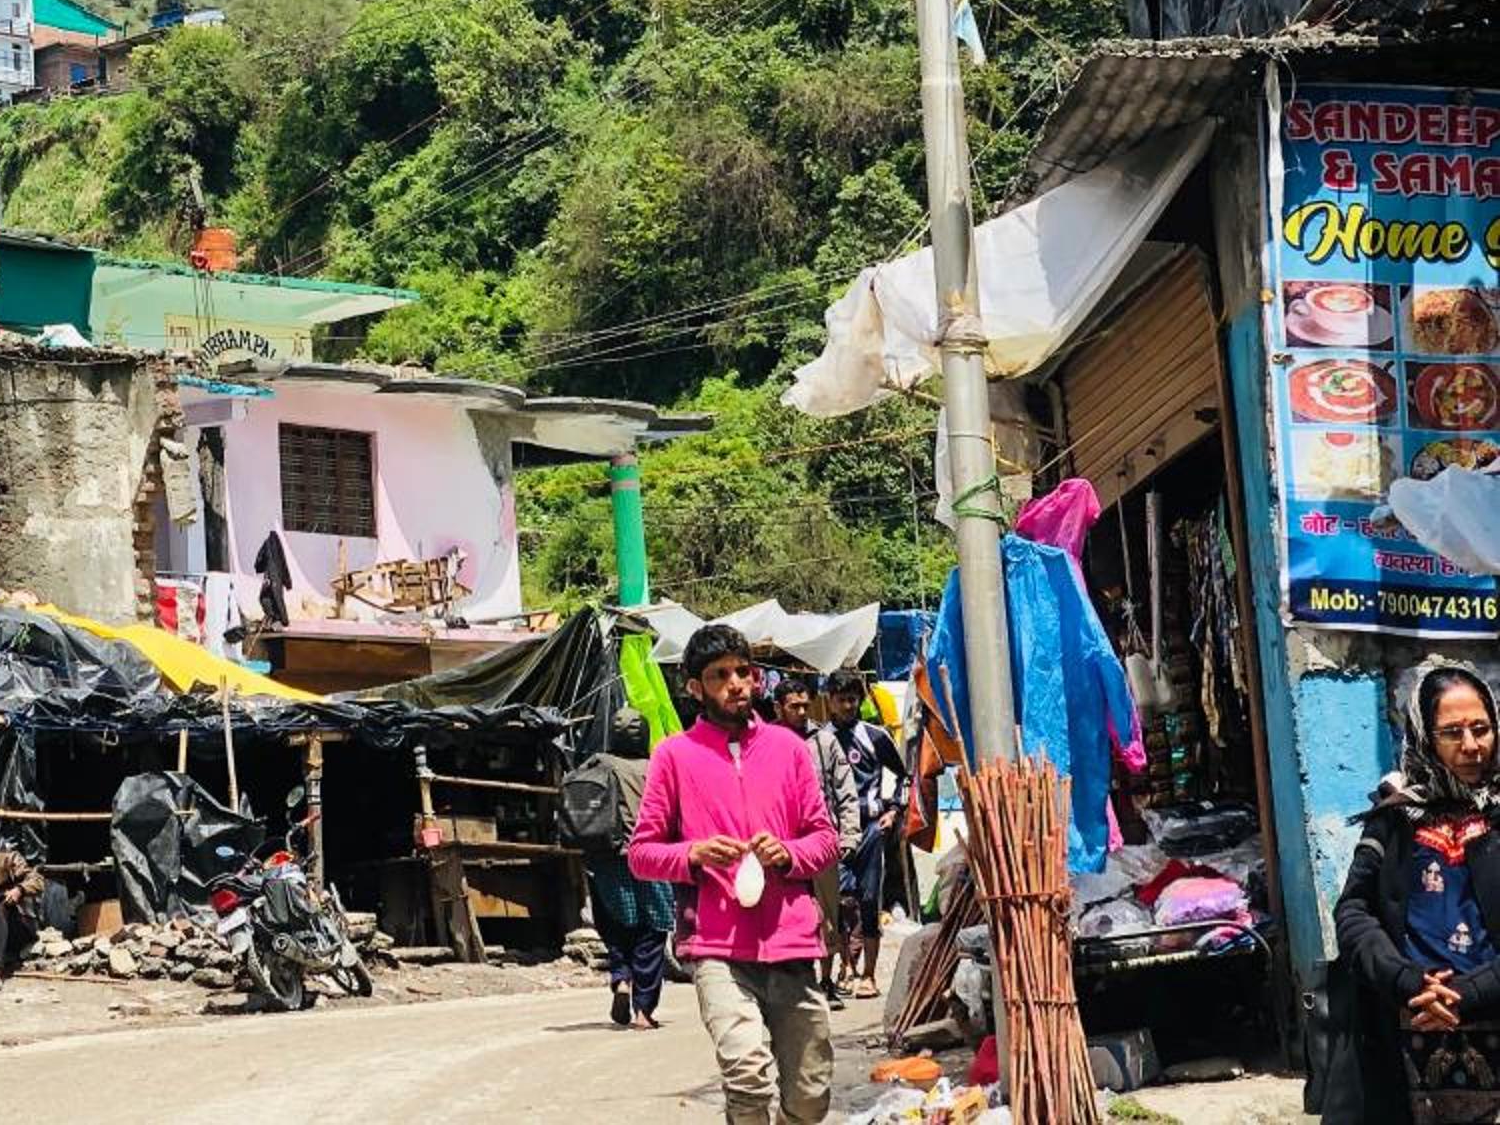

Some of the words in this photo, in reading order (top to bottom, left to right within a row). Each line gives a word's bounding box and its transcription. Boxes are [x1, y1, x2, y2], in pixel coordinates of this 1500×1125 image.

[1285, 100, 1500, 146] SANDEEP
[1321, 148, 1357, 190] &
[1283, 201, 1471, 264] Home
[1301, 510, 1339, 535] नोट
[1378, 591, 1497, 619] 7900474316
